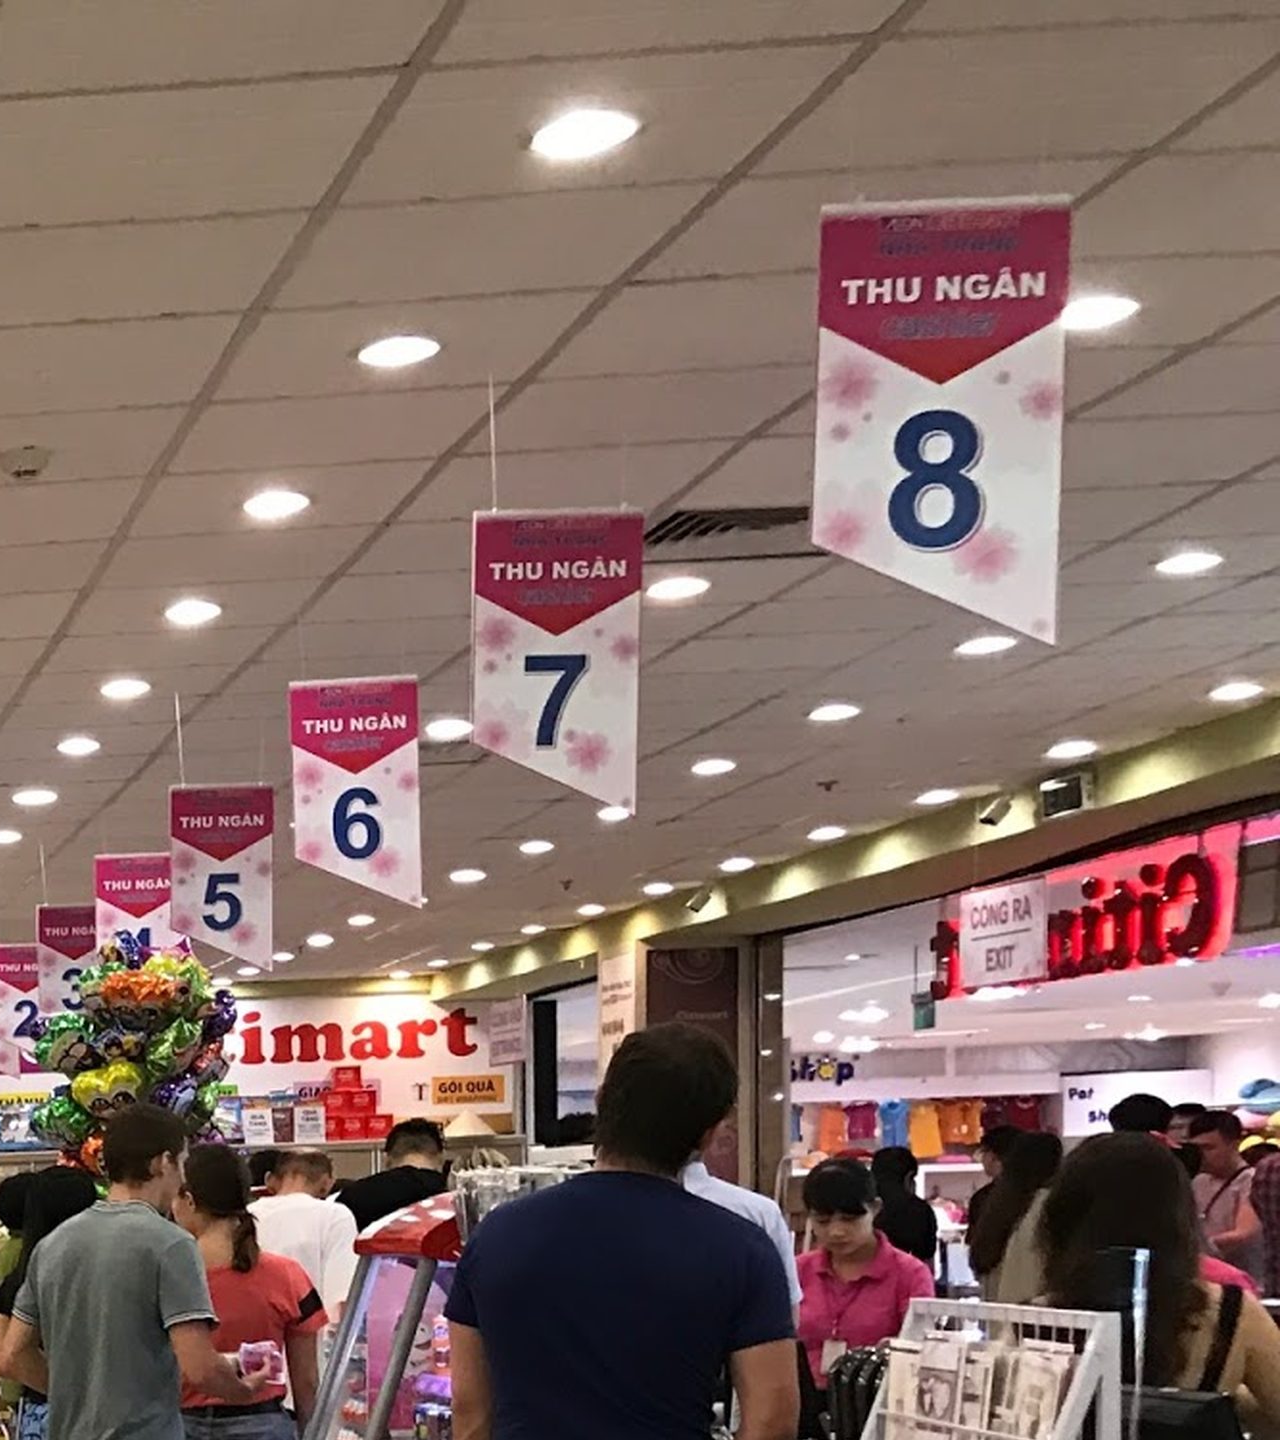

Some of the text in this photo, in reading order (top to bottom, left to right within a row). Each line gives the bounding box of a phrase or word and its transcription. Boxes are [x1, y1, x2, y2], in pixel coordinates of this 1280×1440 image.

[842, 267, 1046, 306] THU NGÂN
[888, 409, 984, 552] 8
[489, 556, 627, 581] THU NGÂN
[524, 654, 590, 750] 7
[302, 713, 407, 734] THU NGÂN
[180, 813, 265, 829] THU NGÂN
[332, 786, 382, 860] 6
[103, 879, 133, 891] THU
[202, 873, 243, 931] 5
[1012, 895, 1032, 923] RA
[45, 926, 71, 938] THU
[0, 963, 22, 974] THU
[985, 945, 1015, 972] EXIT
[61, 968, 85, 1011] 3
[13, 1000, 39, 1039] 2
[239, 1006, 479, 1065] imart
[438, 1079, 463, 1094] GÓI
